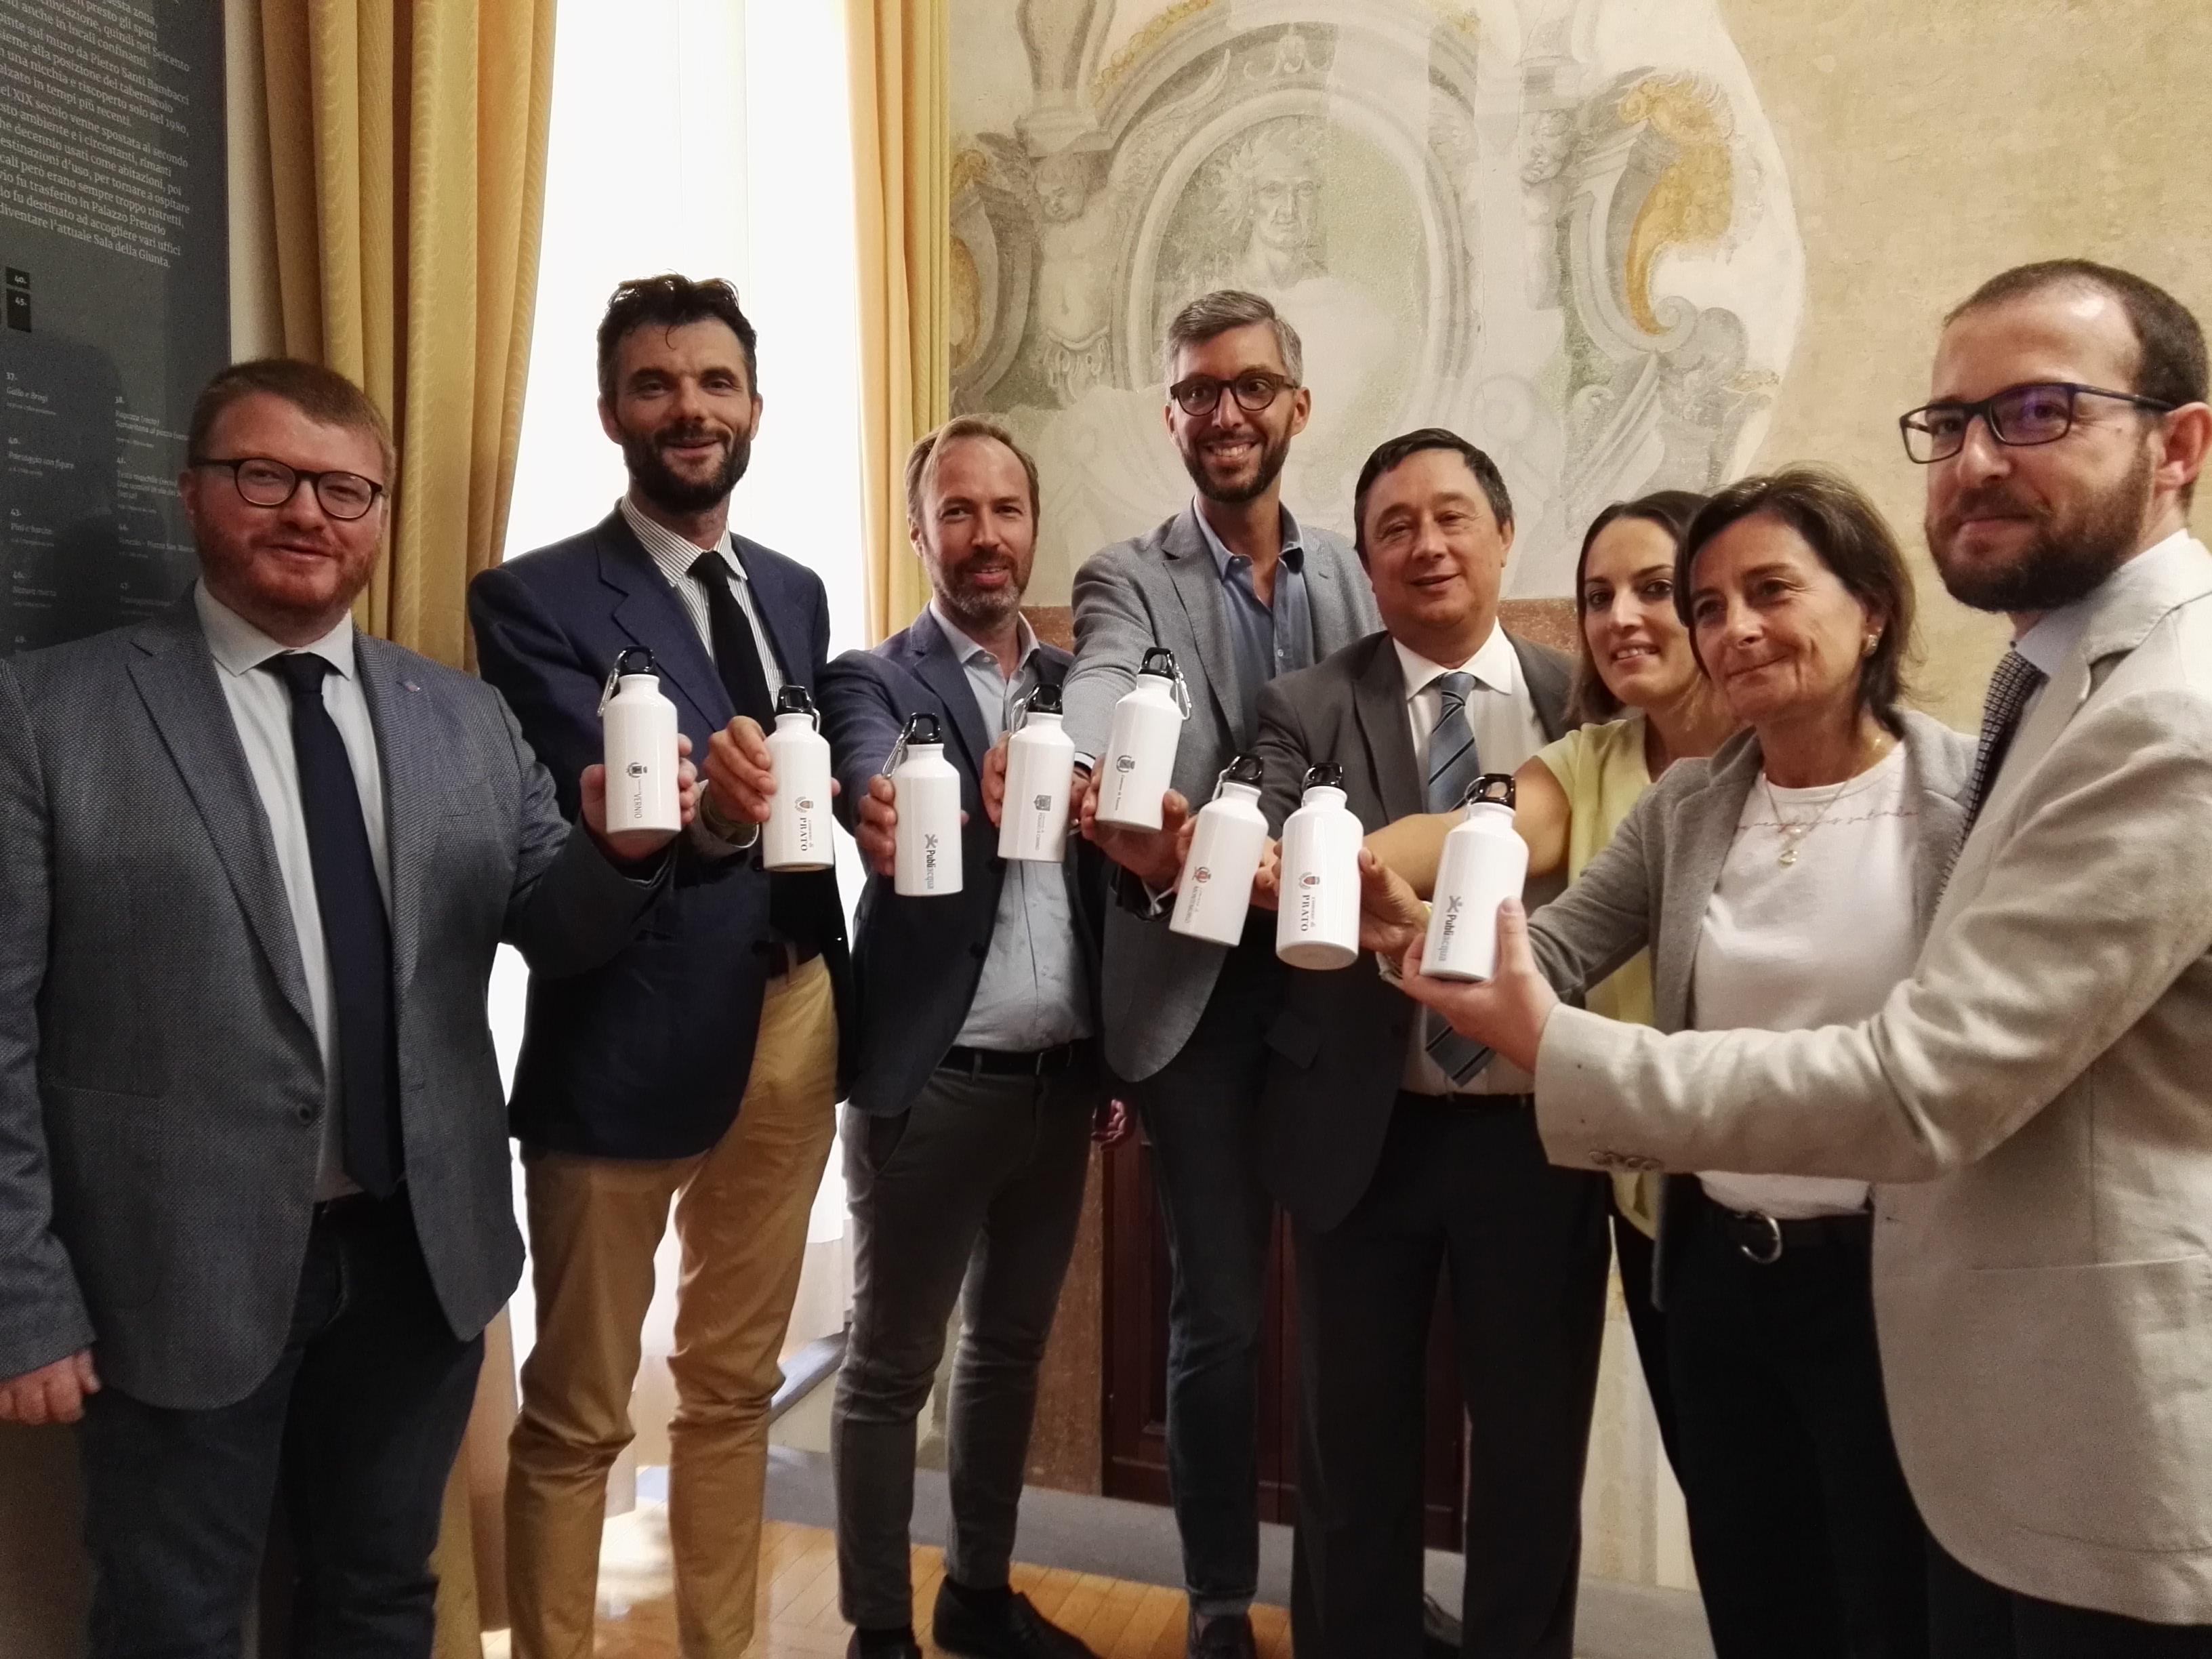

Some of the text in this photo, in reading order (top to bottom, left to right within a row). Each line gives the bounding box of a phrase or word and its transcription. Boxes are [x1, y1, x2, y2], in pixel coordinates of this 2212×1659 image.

[21, 2, 54, 25] anche
[56, 16, 67, 31] in
[68, 22, 96, 45] locali
[97, 39, 148, 69] confinanti.
[86, 0, 157, 42] presto gli spazi
[133, 7, 158, 28] zona,
[27, 26, 44, 41] sul
[45, 34, 75, 54] muro
[76, 46, 89, 60] da
[90, 52, 119, 75] Pietro
[121, 66, 147, 87] Santi
[147, 77, 190, 106] Bambacci
[104, 25, 135, 47] quindi
[136, 41, 150, 54] nel
[152, 46, 190, 72] Seicento
[7, 50, 28, 68] una
[30, 60, 69, 85] nicchia
[70, 77, 77, 87] e
[78, 81, 127, 109] riscoperto
[129, 103, 148, 119] solo
[149, 112, 165, 125] nel
[31, 43, 52, 61] alla
[53, 54, 103, 82] posizione
[103, 75, 118, 90] del
[119, 82, 173, 114] tabernacolo
[33, 77, 44, 91] in
[45, 83, 77, 105] tempi
[78, 98, 95, 112] più
[96, 105, 132, 127] recenti.
[11, 87, 34, 107] XIX
[35, 100, 68, 121] secolo
[70, 114, 101, 134] venne
[101, 127, 141, 150] spostata
[142, 142, 151, 155] al
[152, 147, 189, 169] secondo
[19, 110, 70, 138] ambiente
[70, 131, 77, 141] e
[78, 131, 83, 144] i
[84, 134, 138, 167] circostanti,
[14, 123, 63, 151] decennio
[64, 144, 89, 163] usati
[90, 155, 117, 172] come
[118, 165, 166, 194] abitazioni,
[167, 183, 182, 197] poi
[16, 173, 28, 188] fu
[29, 180, 79, 206] trasferito
[79, 196, 91, 210] in
[91, 200, 129, 224] Palazzo
[129, 213, 167, 237] Pretorio
[20, 160, 45, 178] però
[47, 171, 77, 190] erano
[78, 182, 114, 203] sempre
[115, 194, 147, 215] troppo
[147, 205, 184, 230] ristretti,
[61, 158, 92, 182] d'uso,
[94, 171, 110, 184] per
[111, 176, 147, 199] tornare
[147, 191, 154, 202] a
[155, 194, 191, 215] ospitare
[13, 189, 24, 204] fu
[26, 194, 75, 221] destinato
[75, 212, 89, 226] ad
[89, 218, 138, 242] accogliere
[138, 235, 157, 249] vari
[157, 241, 182, 257] uffici
[49, 218, 92, 244] l'attuale
[93, 233, 115, 250] Sala
[115, 241, 138, 258] della
[138, 249, 171, 269] Giunta.
[15, 296, 28, 306] 45.
[6, 371, 18, 381] 37.
[633, 792, 643, 819] VERNIO
[800, 817, 808, 851] PRATO
[924, 849, 937, 890] Publiacqua
[1300, 895, 1310, 932] PRATO
[1437, 914, 1457, 962] Publiacqua
